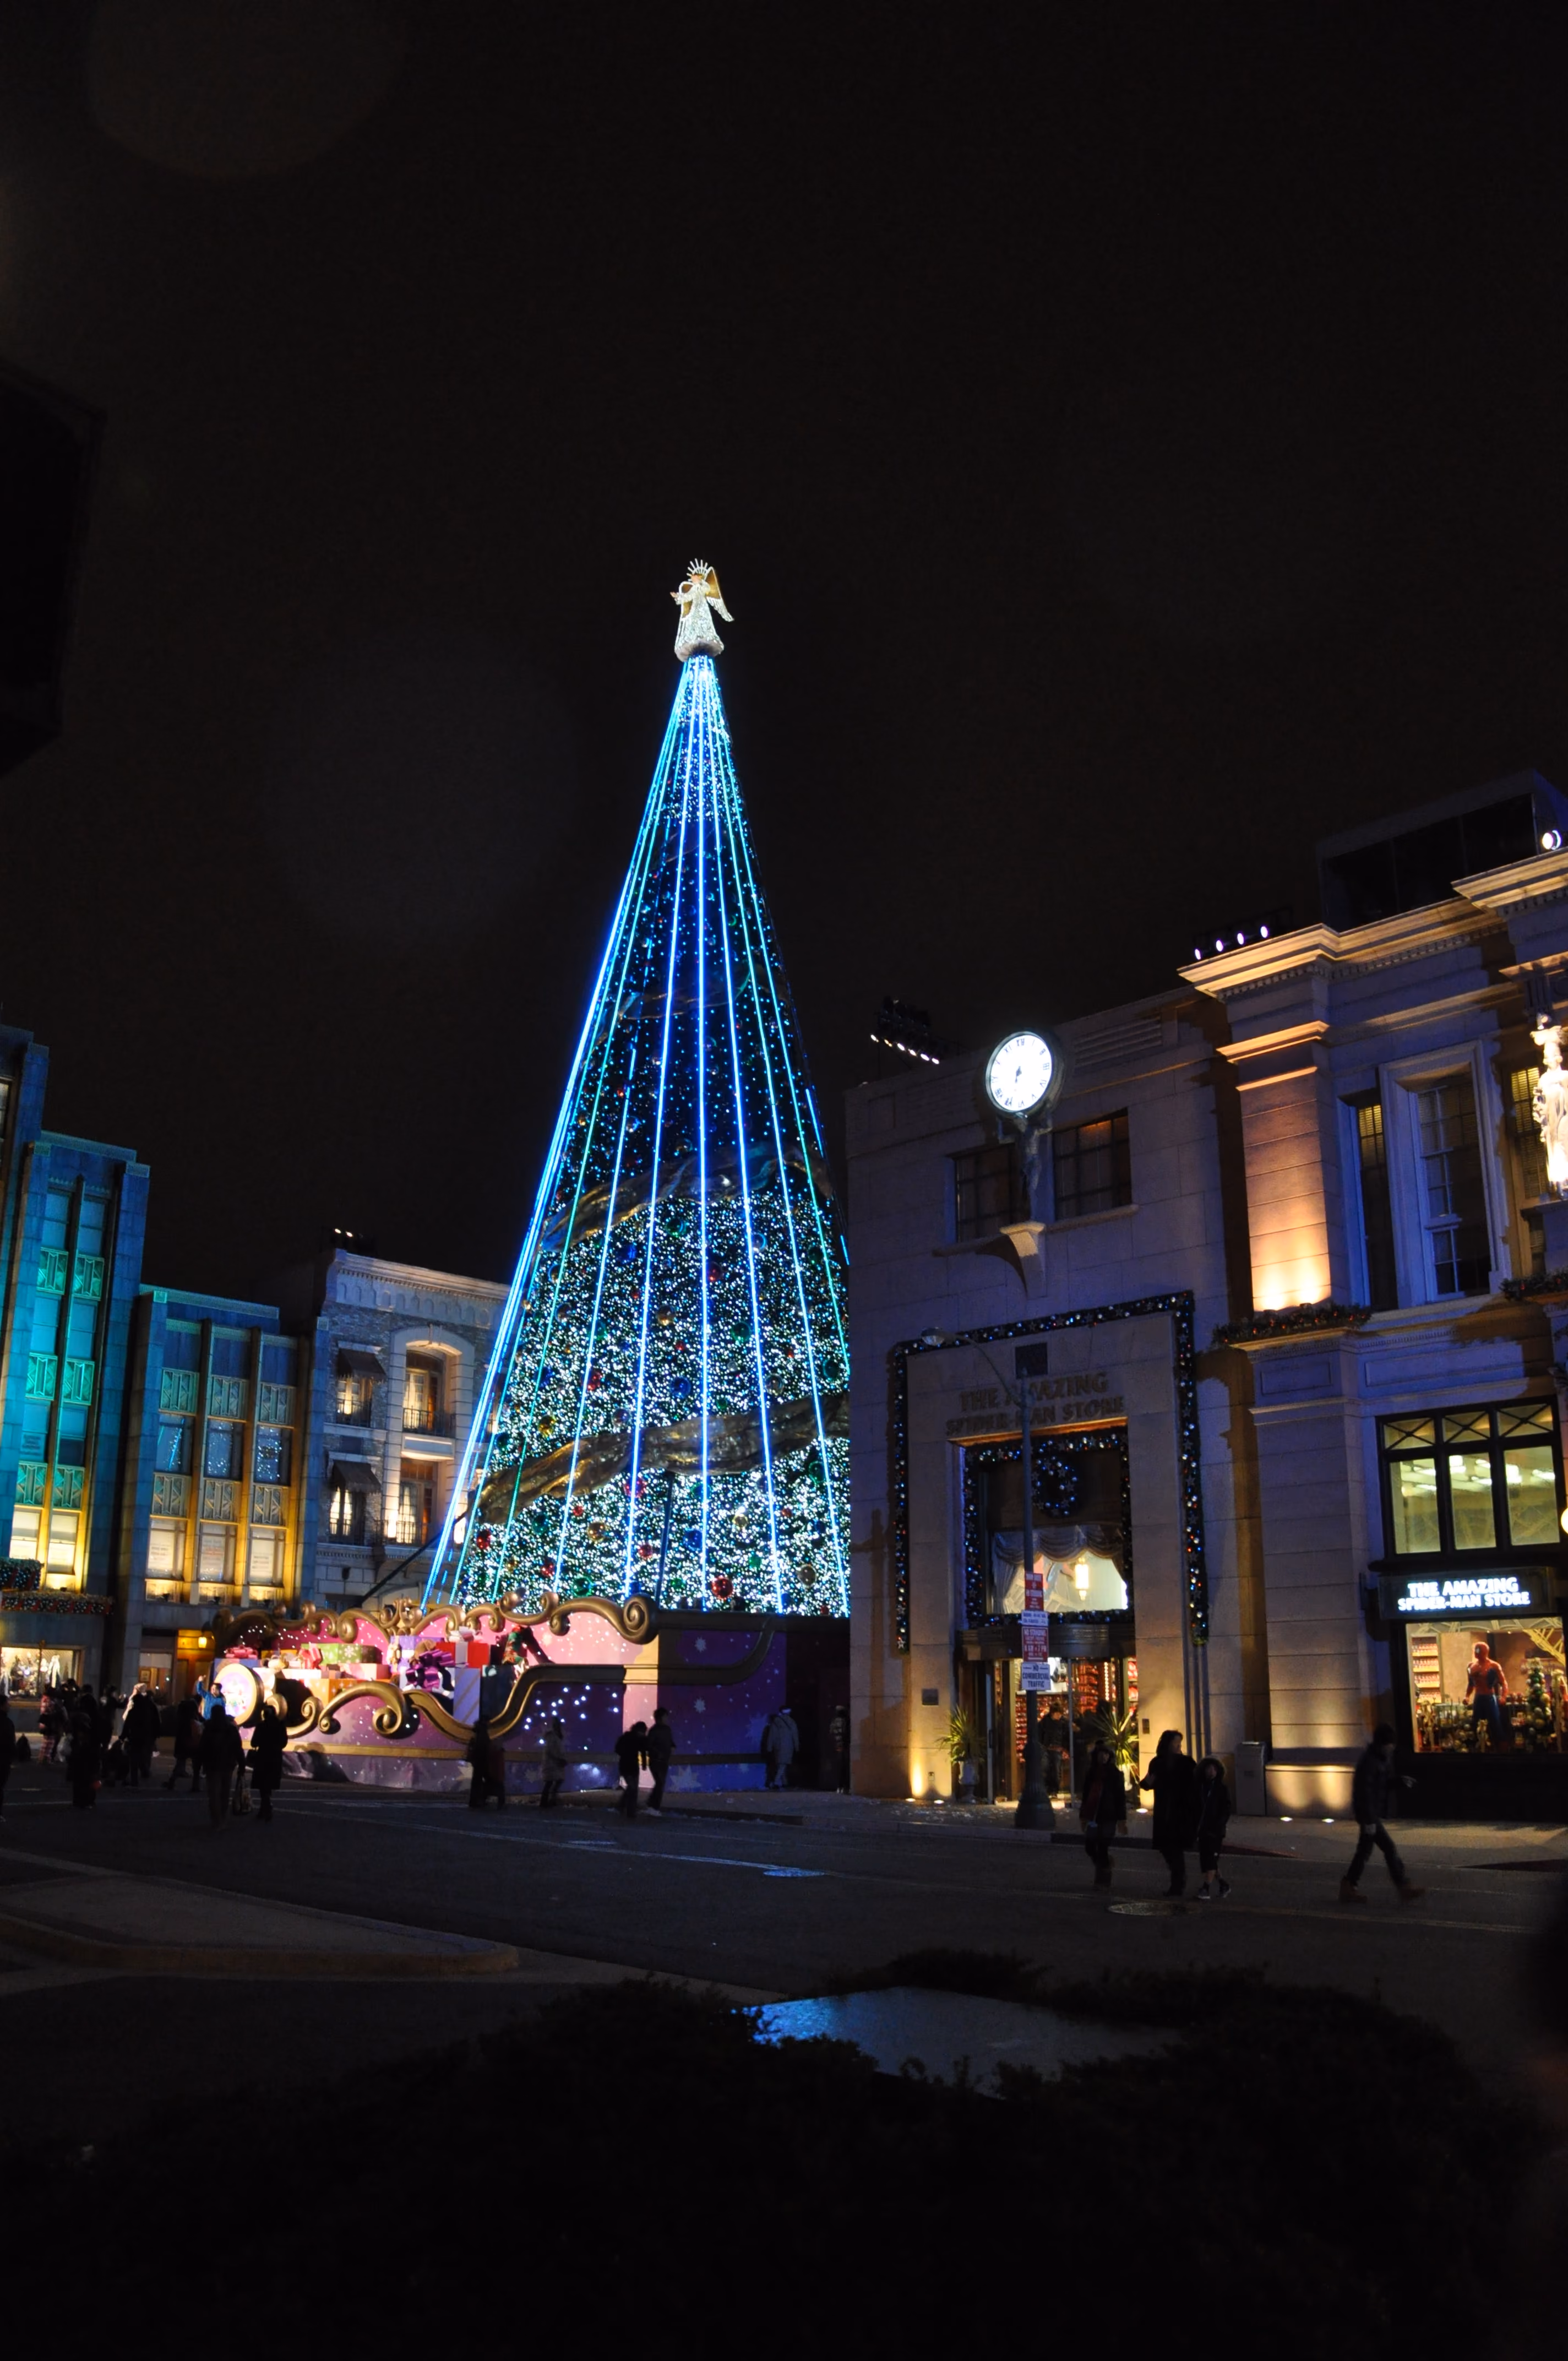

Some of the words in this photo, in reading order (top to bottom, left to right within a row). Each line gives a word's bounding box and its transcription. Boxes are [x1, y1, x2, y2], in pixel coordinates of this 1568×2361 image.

[959, 1388, 998, 1412] THE
[1062, 1395, 1125, 1421] STORE
[1407, 1581, 1440, 1597] THE
[1442, 1577, 1519, 1596] AMAZING
[1397, 1594, 1482, 1611] SPIDER-MAN
[1484, 1591, 1531, 1607] STORE
